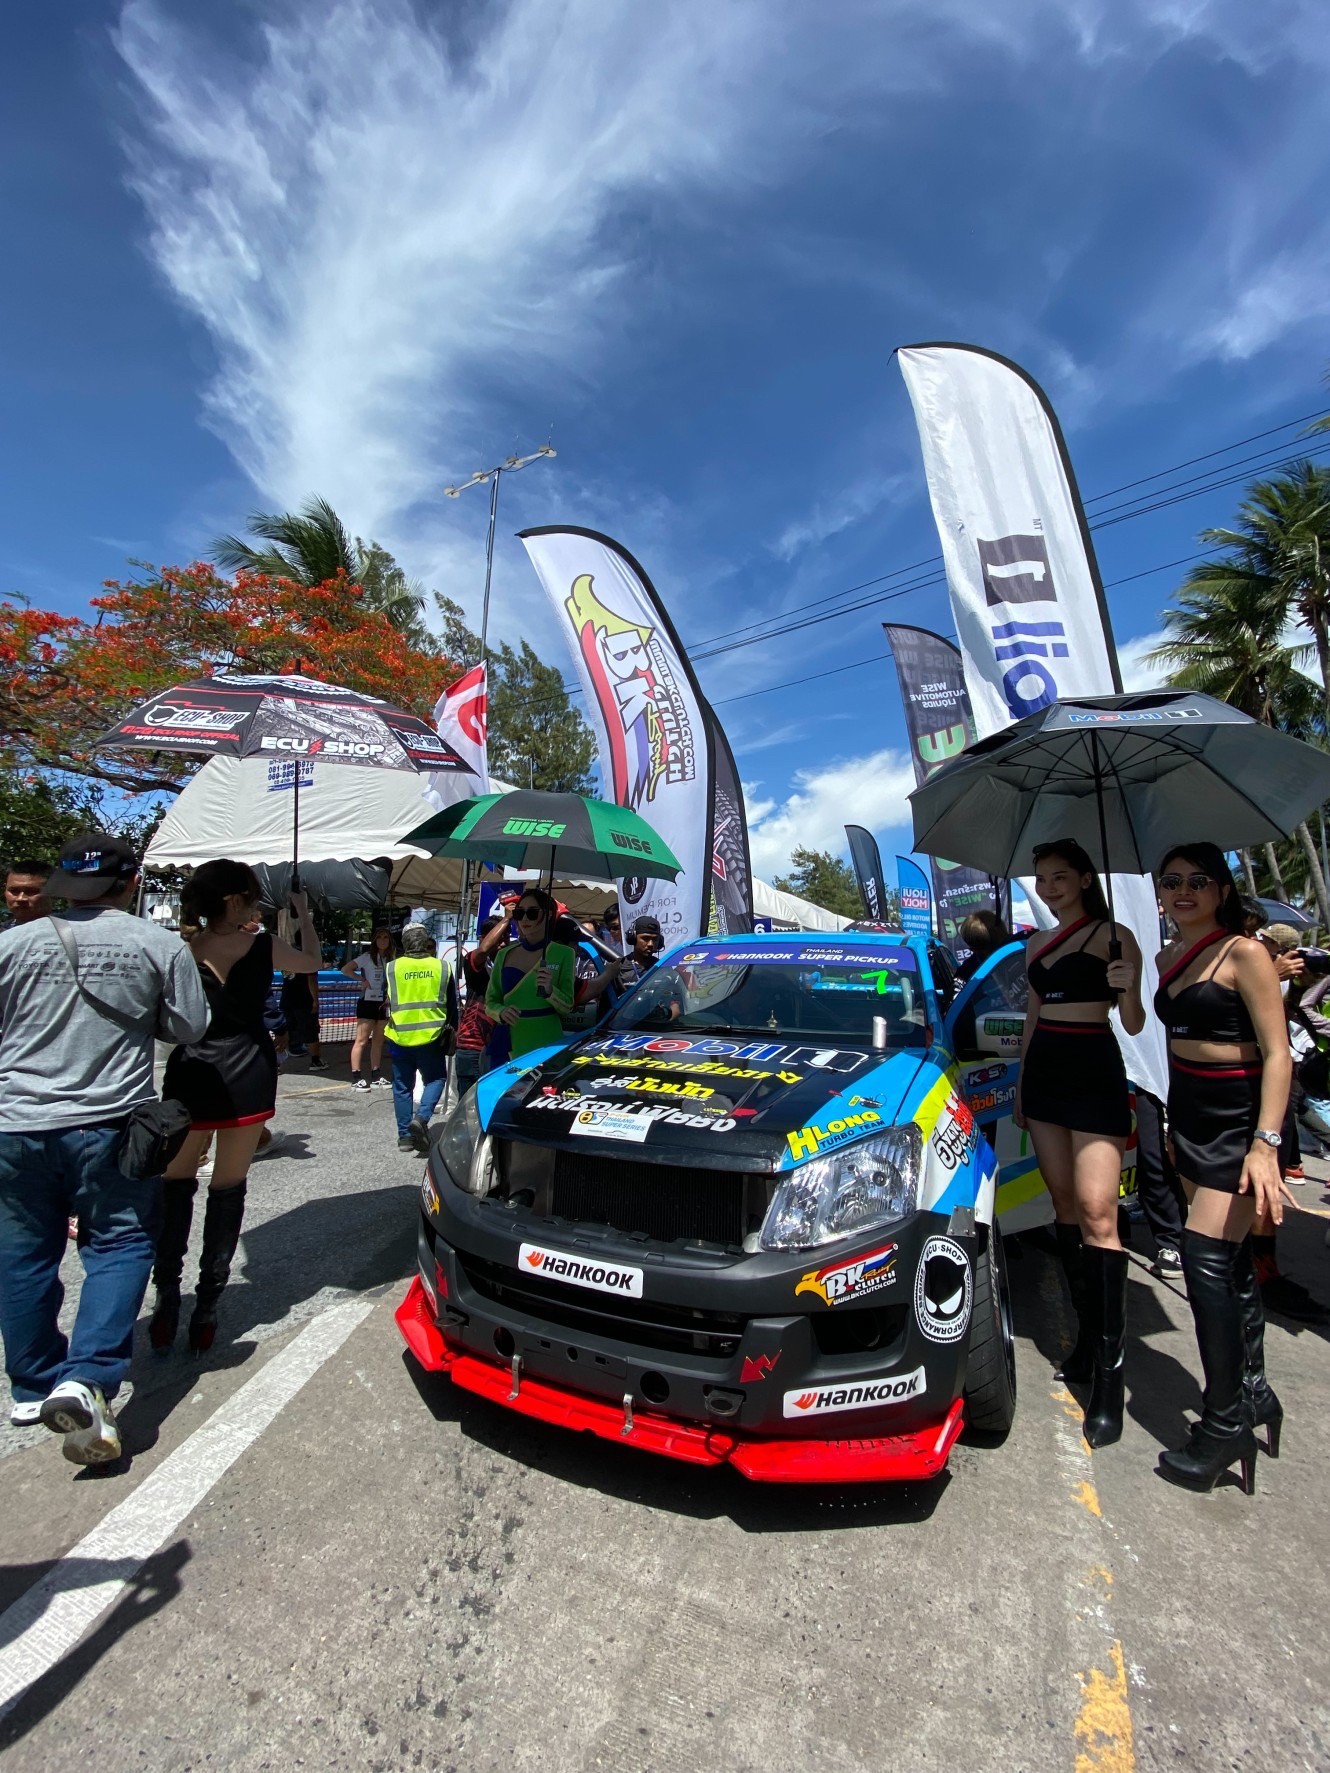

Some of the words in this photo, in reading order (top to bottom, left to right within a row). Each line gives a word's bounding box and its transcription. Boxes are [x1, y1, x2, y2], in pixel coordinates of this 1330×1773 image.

[1069, 713, 1162, 722] Mobil
[261, 736, 310, 751] ECU
[323, 741, 385, 756] SHOP
[502, 821, 567, 839] WISE
[611, 832, 653, 855] WISE
[798, 953, 842, 962] SUPER
[844, 955, 899, 965] PICKUP
[404, 970, 434, 981] OFFICIAL
[984, 1018, 1024, 1036] WISE
[584, 1035, 788, 1061] Mobil
[1001, 1037, 1023, 1046] Mob
[605, 1116, 636, 1125] THAILAND
[623, 1123, 646, 1132] SERIES
[787, 1111, 881, 1162] HLONG
[820, 1129, 855, 1149] TURBO
[859, 1120, 885, 1132] TEAM
[826, 1262, 866, 1299] BK
[854, 1270, 897, 1291] CLUTCH
